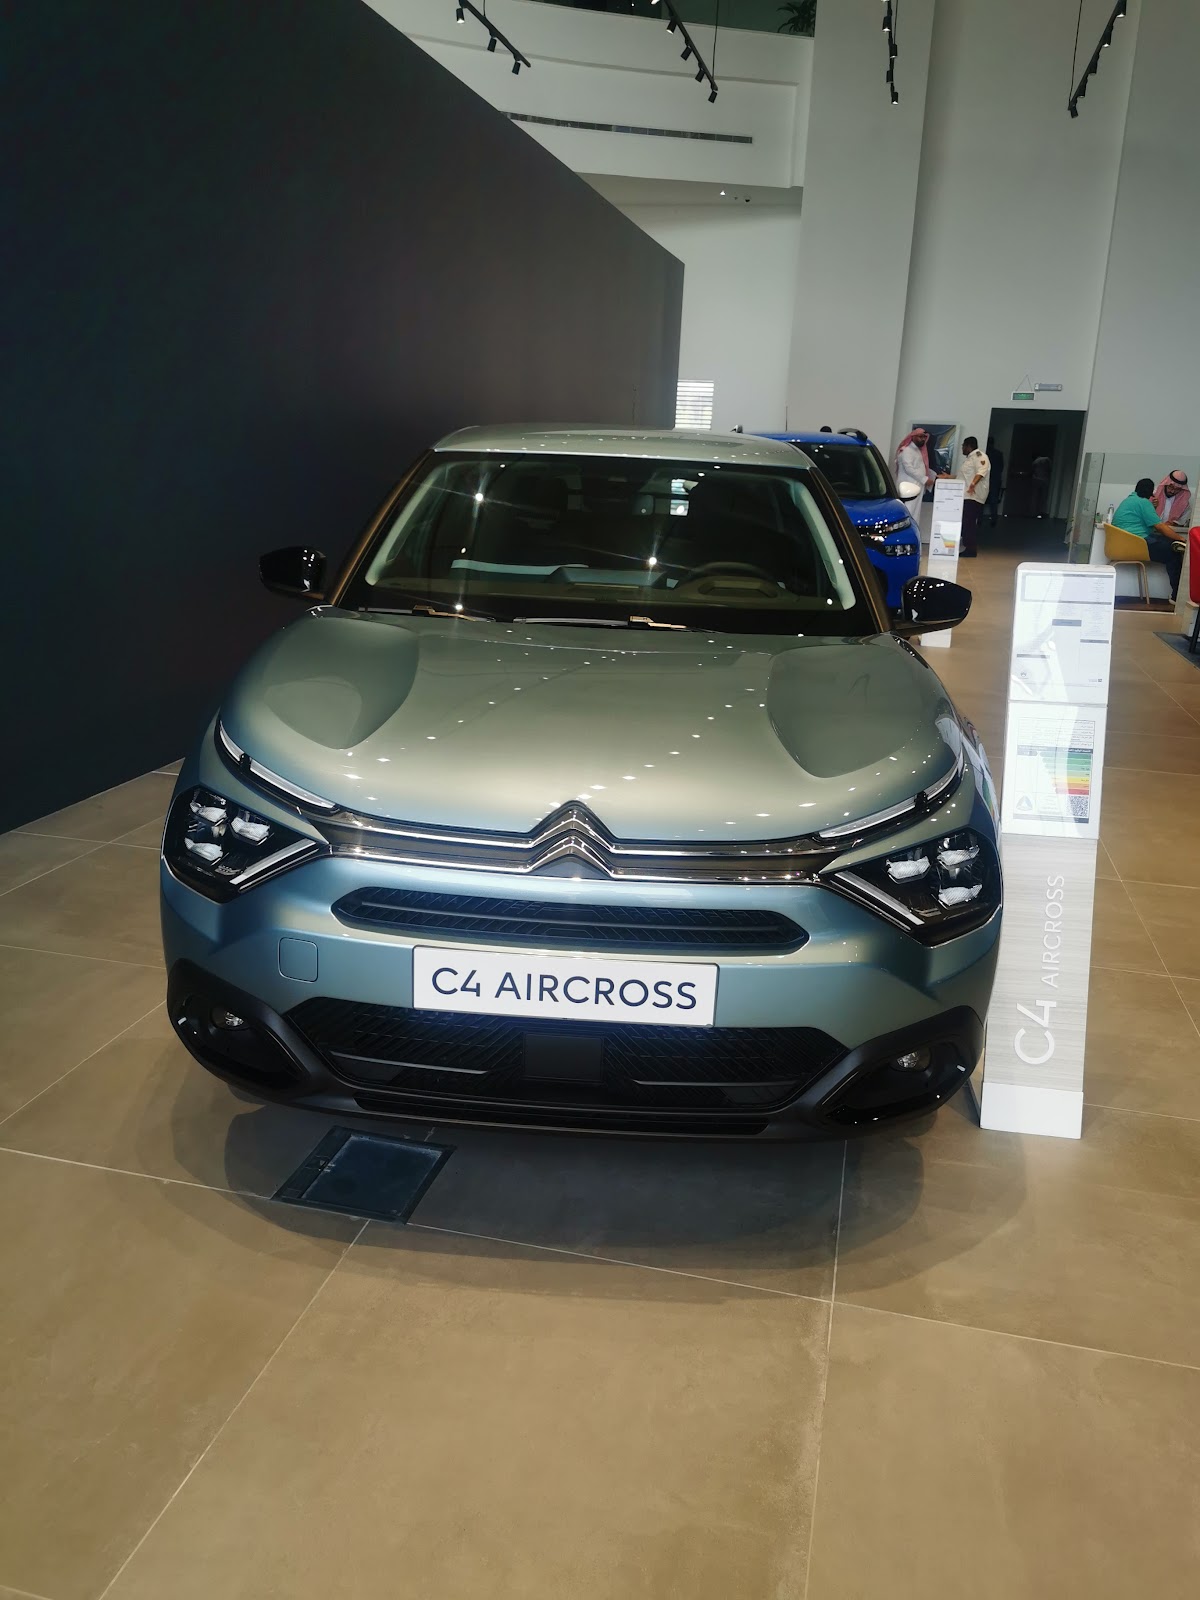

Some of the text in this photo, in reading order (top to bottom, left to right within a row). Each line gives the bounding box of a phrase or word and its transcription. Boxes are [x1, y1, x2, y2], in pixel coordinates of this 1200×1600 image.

[431, 967, 697, 1010] C4 AIRCROSS
[1013, 874, 1064, 1065] C4 AIRCROSS
